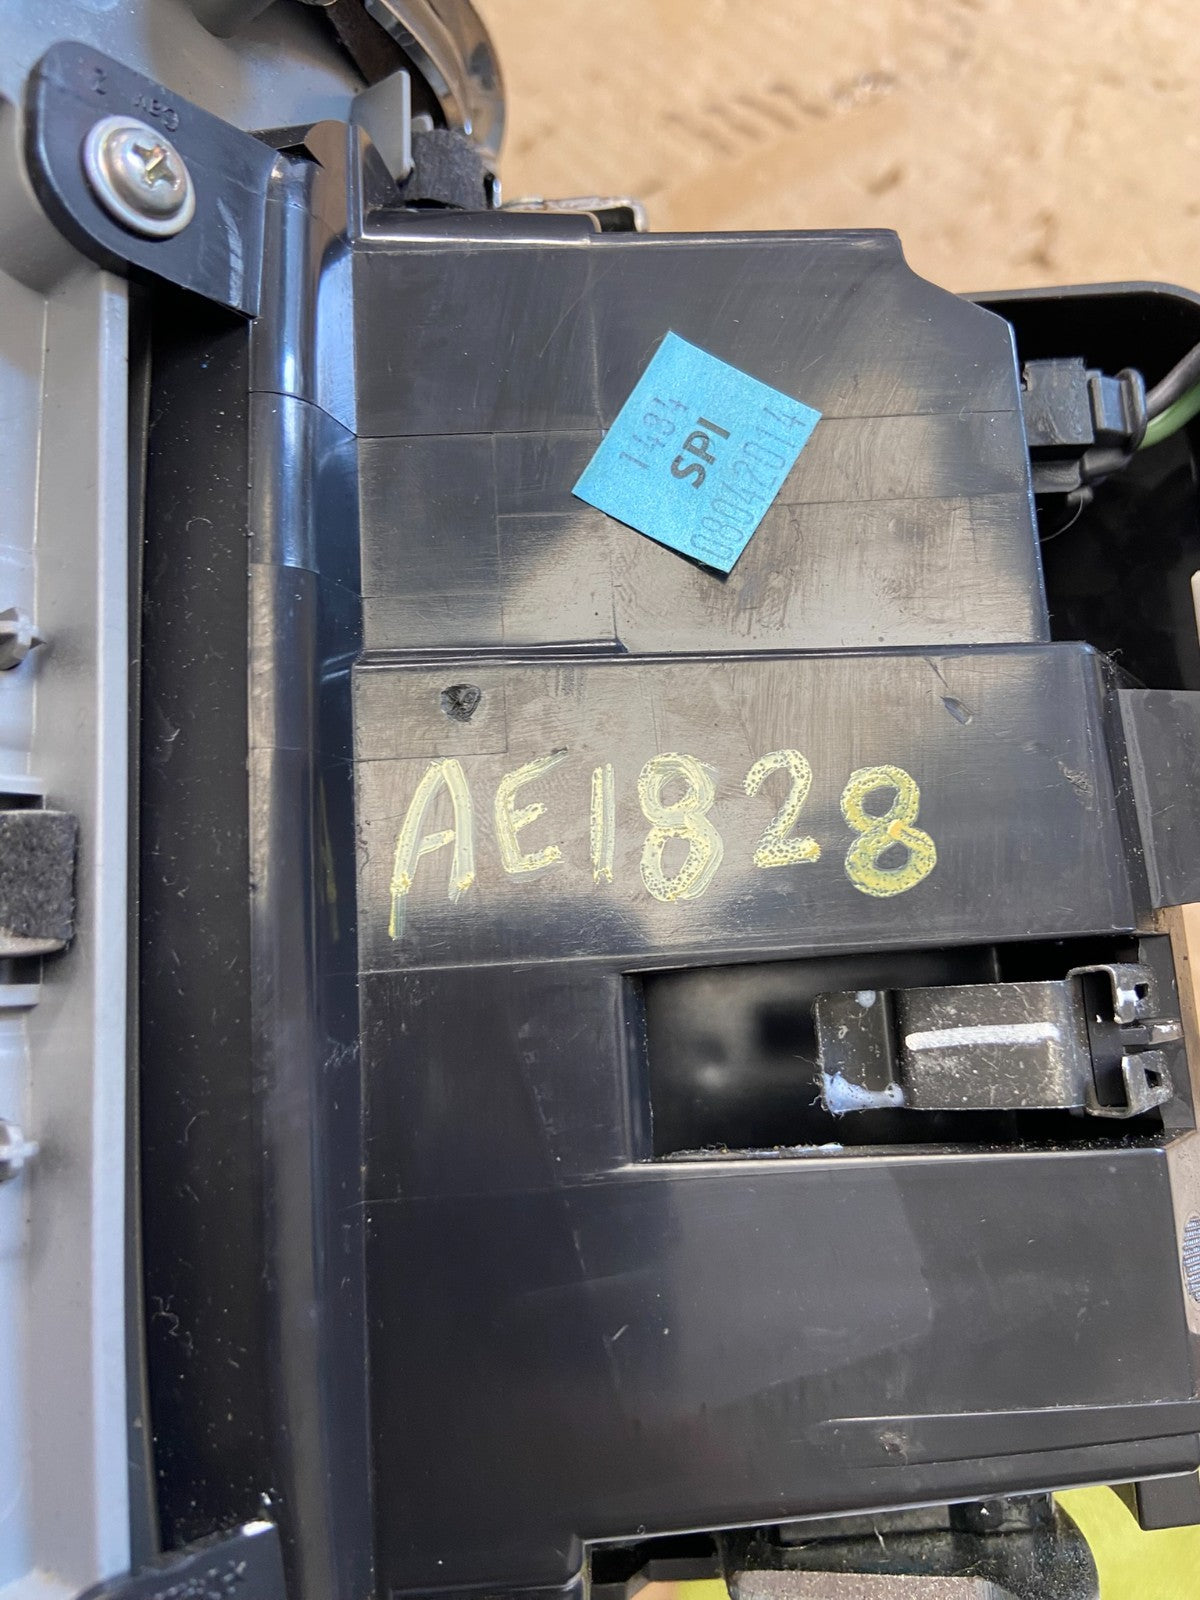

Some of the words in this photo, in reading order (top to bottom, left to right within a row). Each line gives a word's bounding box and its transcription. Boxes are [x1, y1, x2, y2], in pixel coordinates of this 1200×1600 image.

[618, 396, 689, 471] 1434
[669, 416, 732, 490] SPI
[690, 406, 807, 561] 08042014
